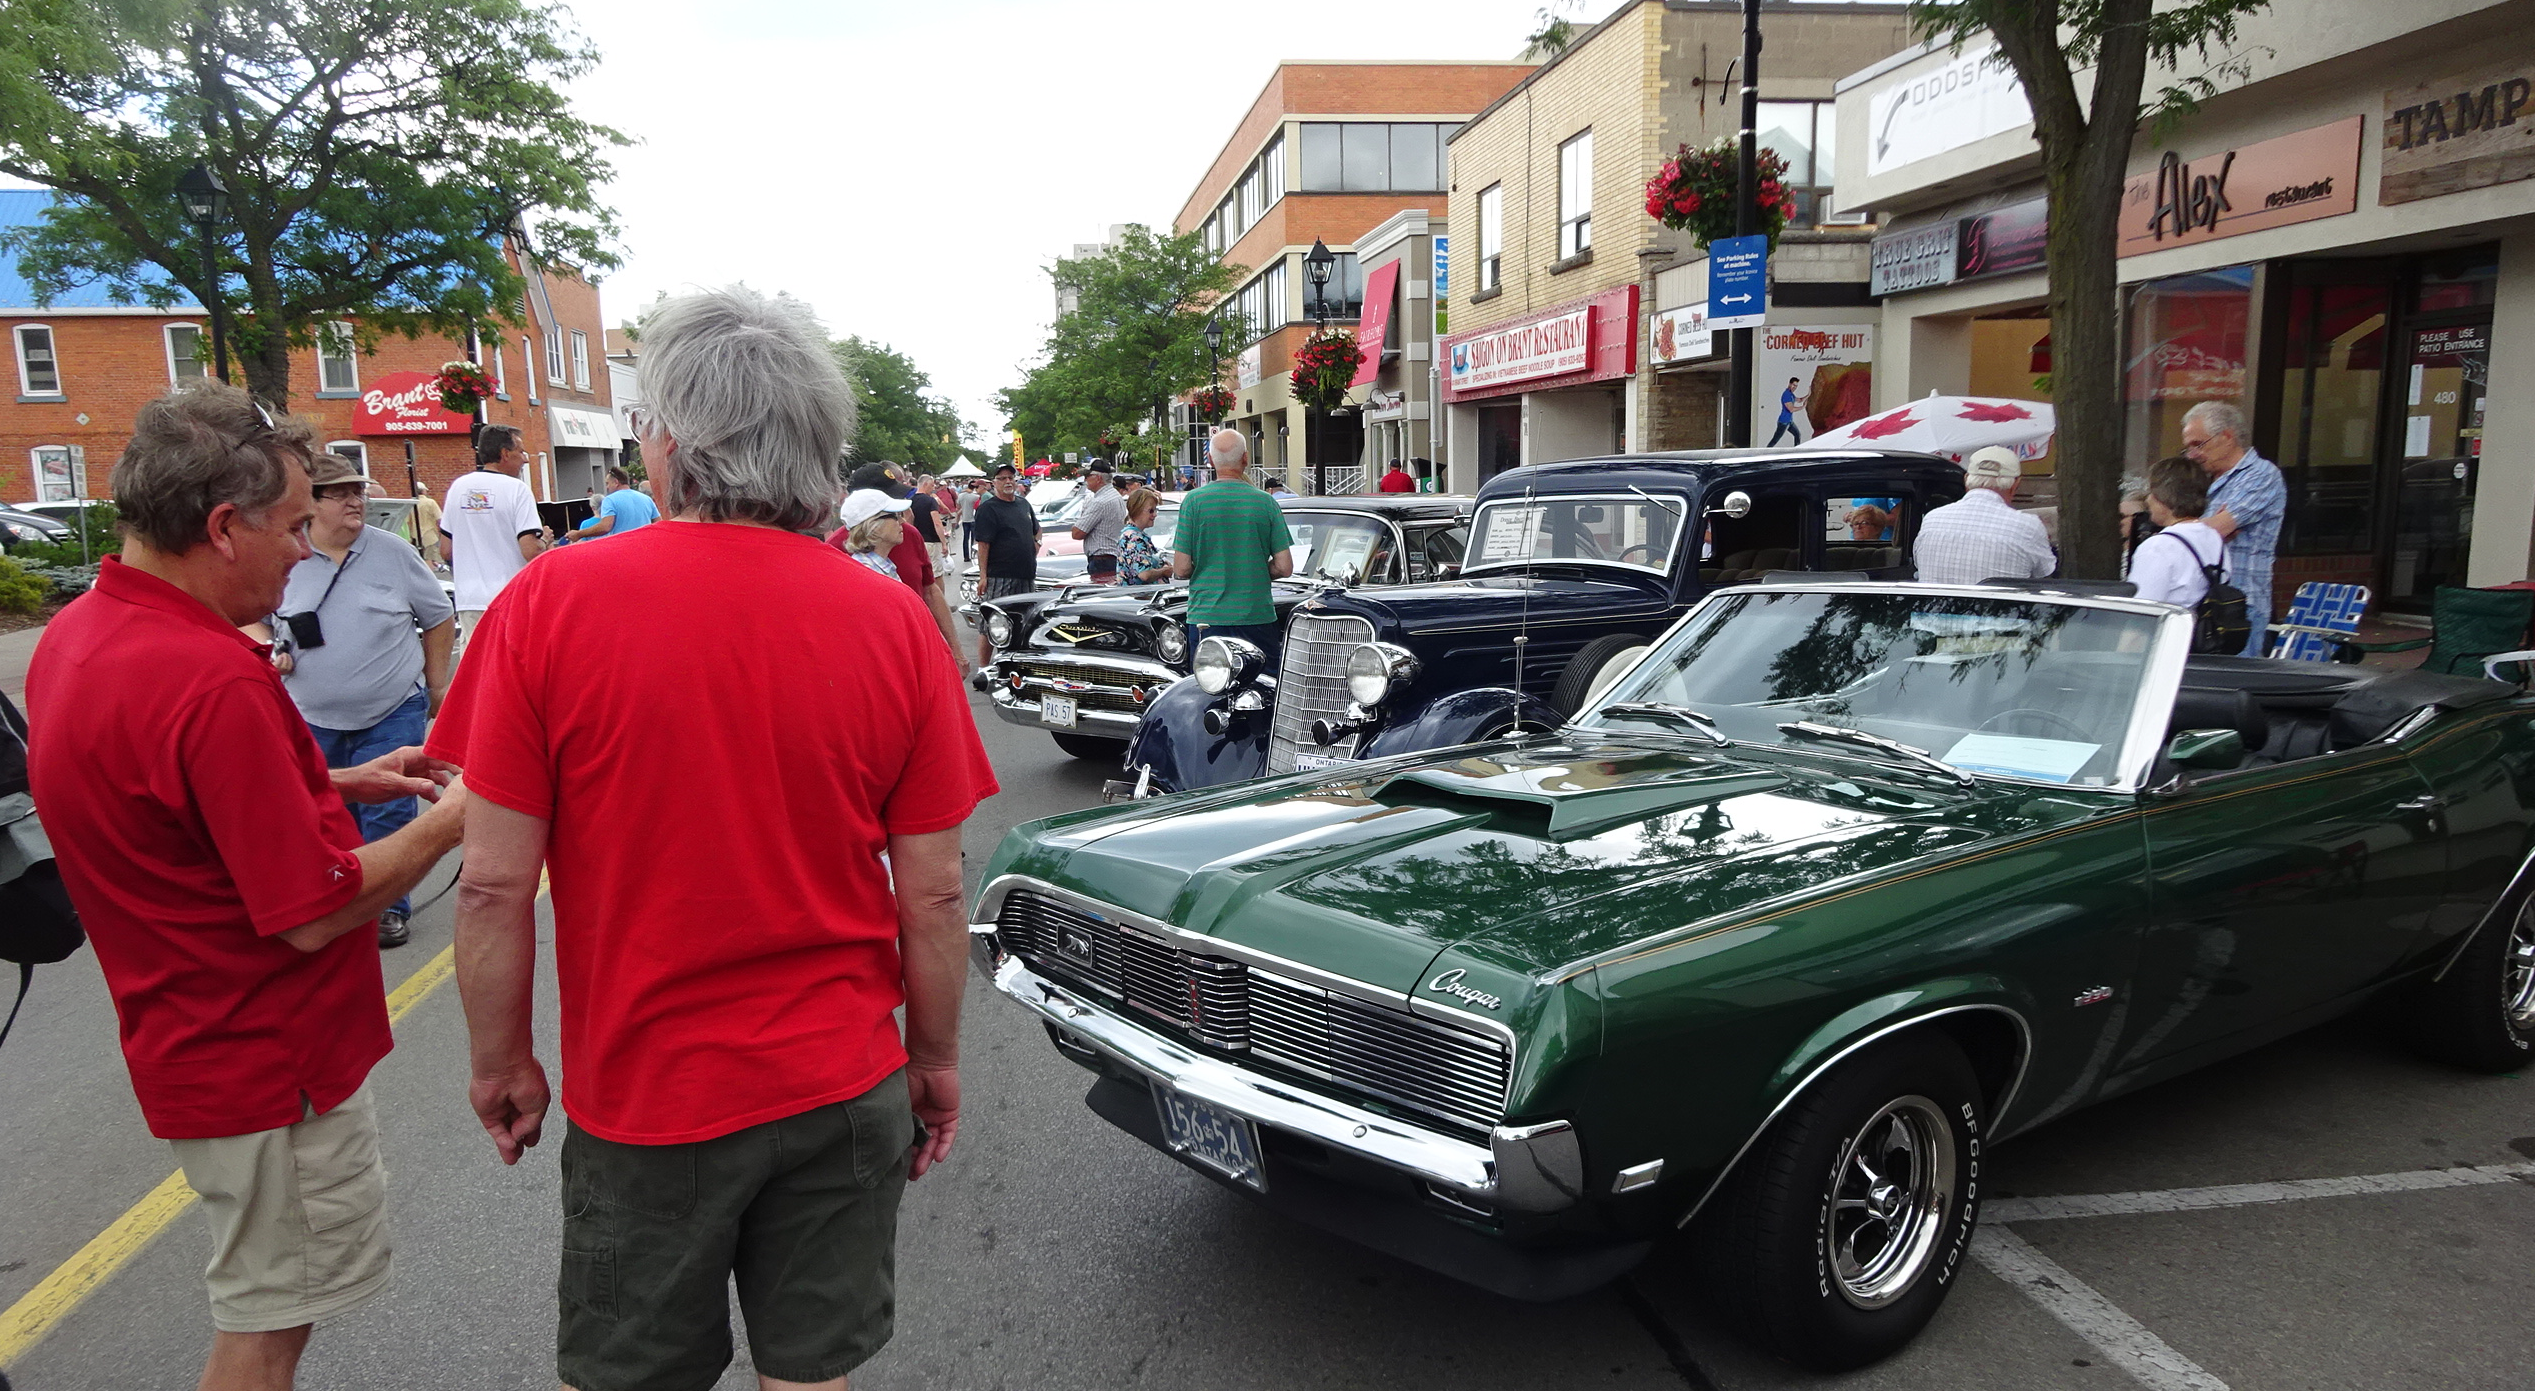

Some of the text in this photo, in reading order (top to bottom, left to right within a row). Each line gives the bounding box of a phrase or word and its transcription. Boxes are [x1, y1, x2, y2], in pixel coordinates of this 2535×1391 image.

[2394, 77, 2532, 151] TAMP
[2147, 150, 2238, 242] Alex
[2265, 175, 2334, 209] restaurant
[1726, 254, 1745, 262] Parking
[1745, 252, 1759, 260] Rules
[1873, 227, 1951, 269] TRUE GRIT
[1882, 260, 1940, 292] TATTOOS
[1471, 314, 1587, 370] SAIGON ON BRANT RESTAURANT
[1766, 333, 1865, 350] CORNED BEEF HUT
[2418, 338, 2486, 354] PATIO ENTRANCE
[2420, 327, 2476, 343] PLEASE USE
[363, 382, 425, 415] Brant
[395, 406, 430, 419] Florist
[2434, 391, 2457, 404] 480
[385, 421, 448, 432] 905-639-7001
[1046, 702, 1071, 720] PAS 57
[1428, 968, 1502, 1011] Cougar
[1937, 1102, 1980, 1285] BFGoodrich
[1817, 1193, 1830, 1298] Radial
